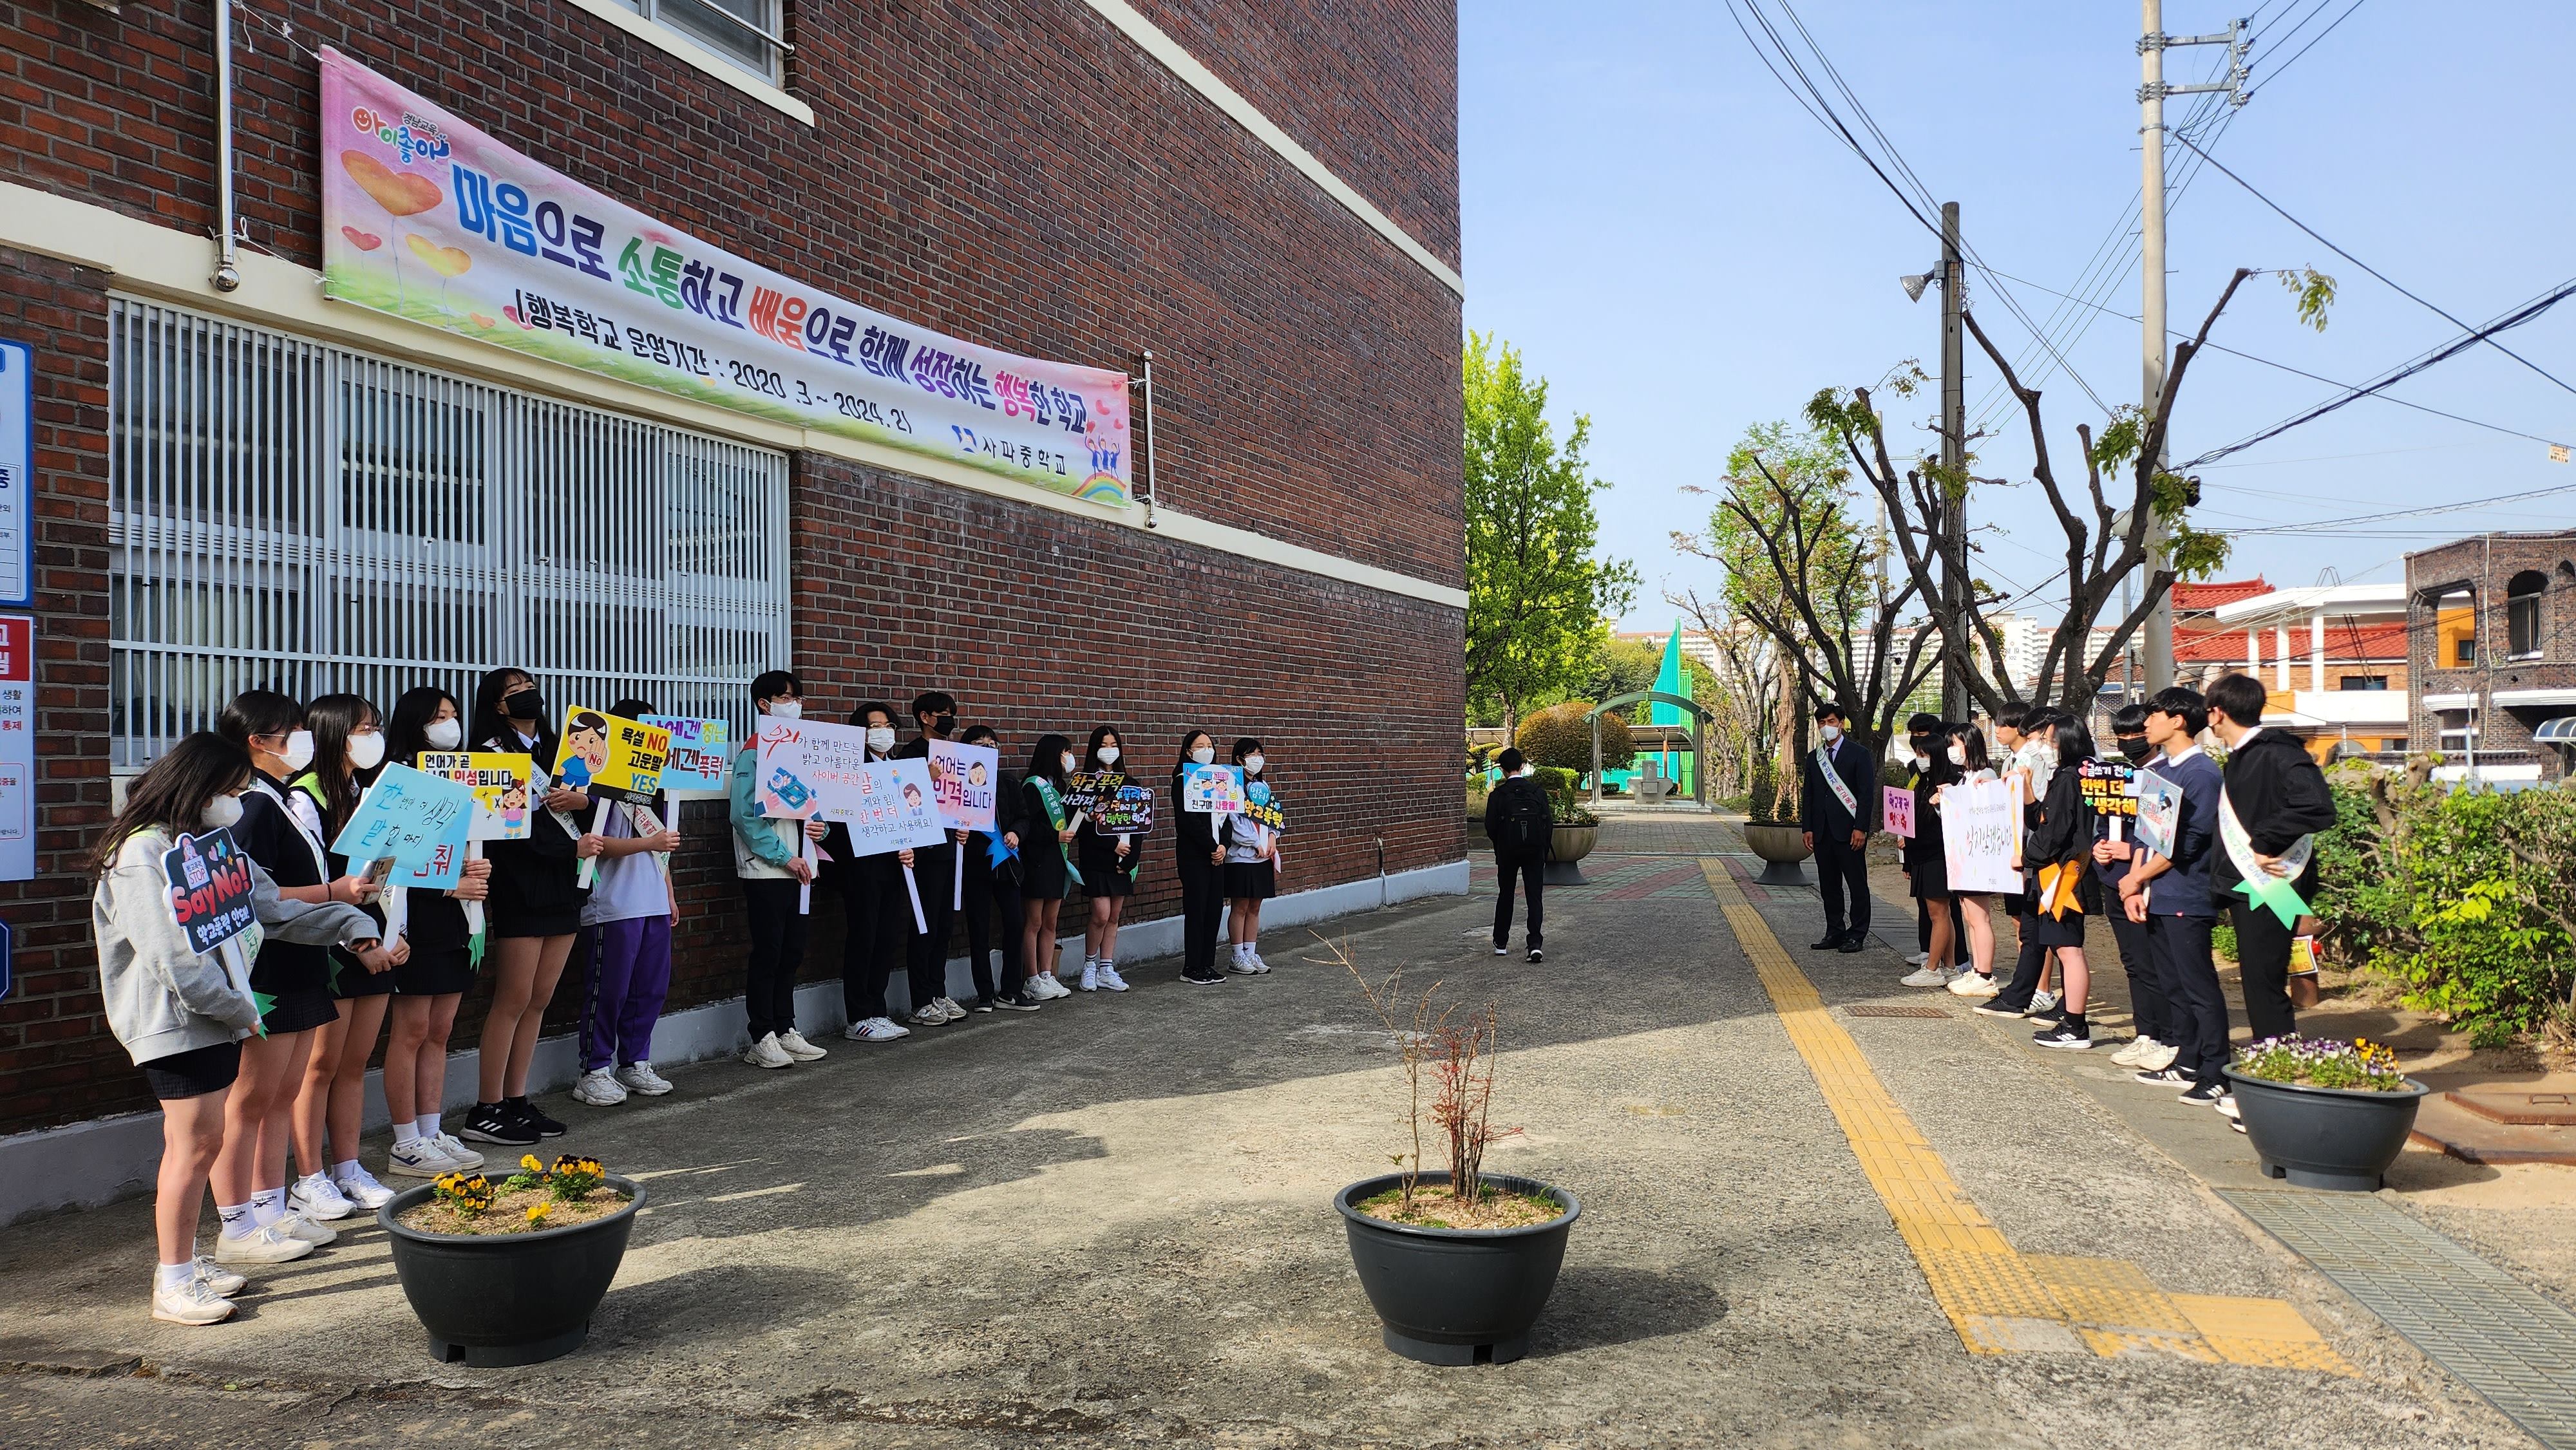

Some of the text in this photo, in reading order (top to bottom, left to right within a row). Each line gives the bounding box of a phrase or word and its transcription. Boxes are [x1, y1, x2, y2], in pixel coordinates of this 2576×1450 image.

[403, 113, 437, 136] 경남교육
[352, 108, 450, 164] 아이좋아
[452, 164, 1088, 434] 마음으로 소통하고 배움으로 함께 성장하는 행복한 학교
[515, 288, 623, 349] (행복학교
[626, 326, 710, 377] 운영기간
[729, 360, 785, 399] 2020
[982, 435, 1067, 476] 사파중학교
[0, 704, 22, 716] 하여
[2, 720, 22, 731] 통제
[703, 722, 727, 744] 장난
[621, 727, 668, 753] 욕설 NO
[811, 737, 830, 751] 함께
[833, 740, 860, 755] 만드는
[425, 754, 470, 769] 언어가 곧
[627, 750, 664, 773] 고운말
[698, 755, 724, 781] 폭력
[802, 753, 860, 771] 밝고 아름다운
[2087, 763, 2125, 777] 글쓰기 전
[454, 769, 513, 786] 인성입니다
[630, 773, 658, 794] YES
[812, 769, 860, 786] 사이버 공간
[1070, 773, 1125, 793] 학교 폭력
[933, 778, 992, 809] 인격입니다
[1250, 786, 1269, 803] 멈춰!
[2109, 779, 2125, 796] 더
[861, 795, 881, 807] 게와
[1060, 793, 1099, 806] 사라져!
[1192, 799, 1238, 811] 친구야 사랑해!
[2093, 796, 2138, 815] 생각해
[887, 805, 898, 818] 더
[1106, 812, 1132, 825] 행복한
[1244, 798, 1283, 829] 학교폭력
[861, 817, 933, 838] 생각하고 사용해요!
[189, 869, 206, 885] STOP
[171, 856, 251, 923] Say No!
[196, 912, 232, 946] 학교폭력
